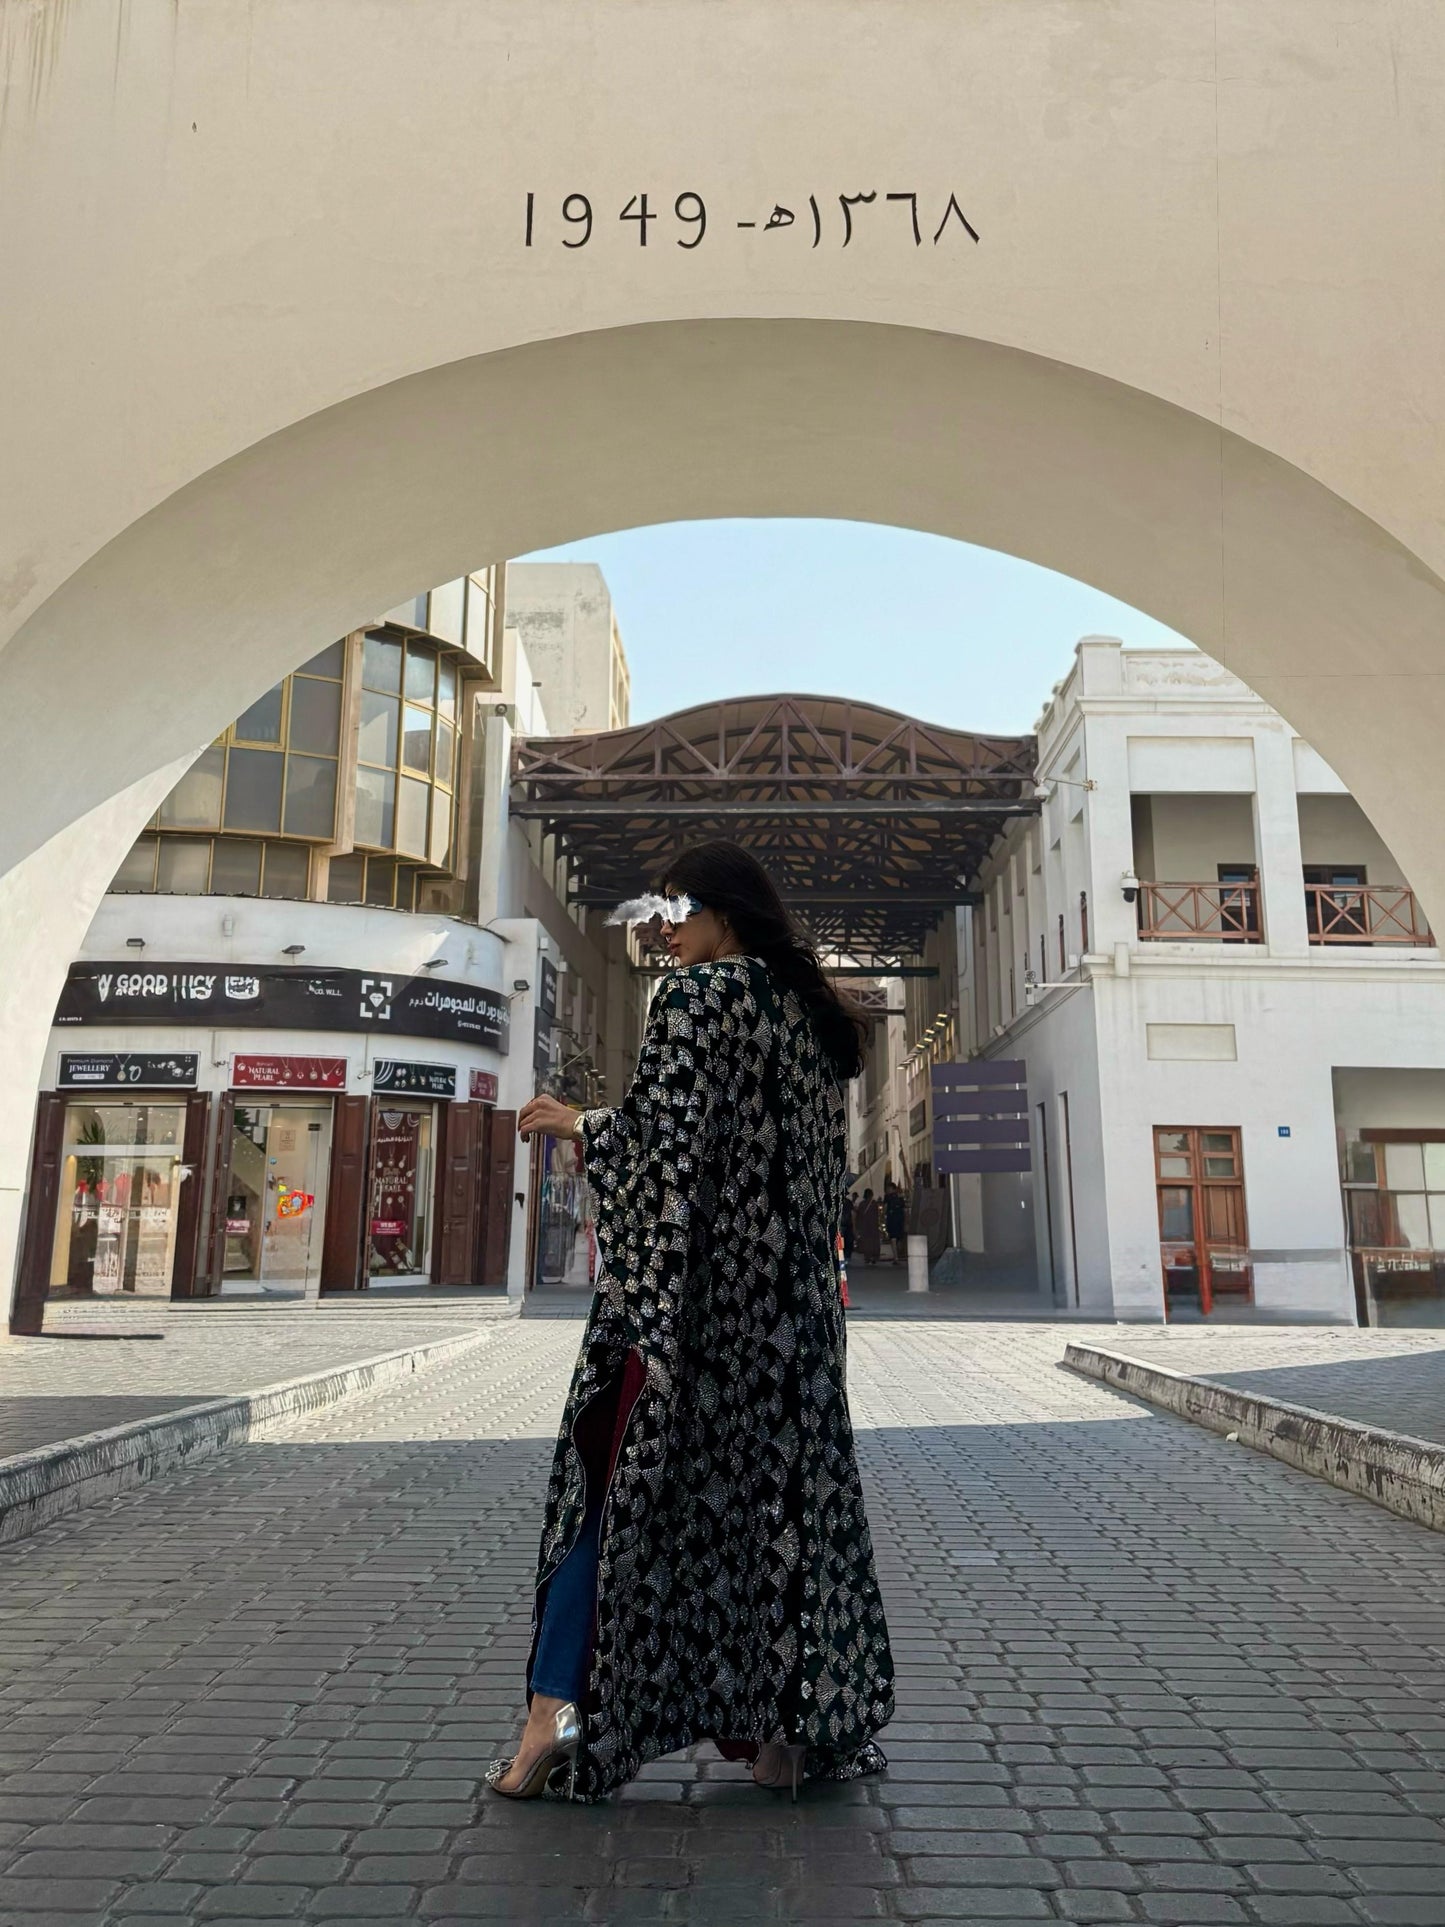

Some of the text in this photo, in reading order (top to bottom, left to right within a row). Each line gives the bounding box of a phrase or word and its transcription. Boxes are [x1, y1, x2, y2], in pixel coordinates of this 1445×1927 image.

[525, 192, 706, 249] 1949
[425, 992, 475, 1015] للمجوهرات
[68, 1064, 110, 1074] JEWELLERY
[248, 1066, 280, 1075] NATURAL
